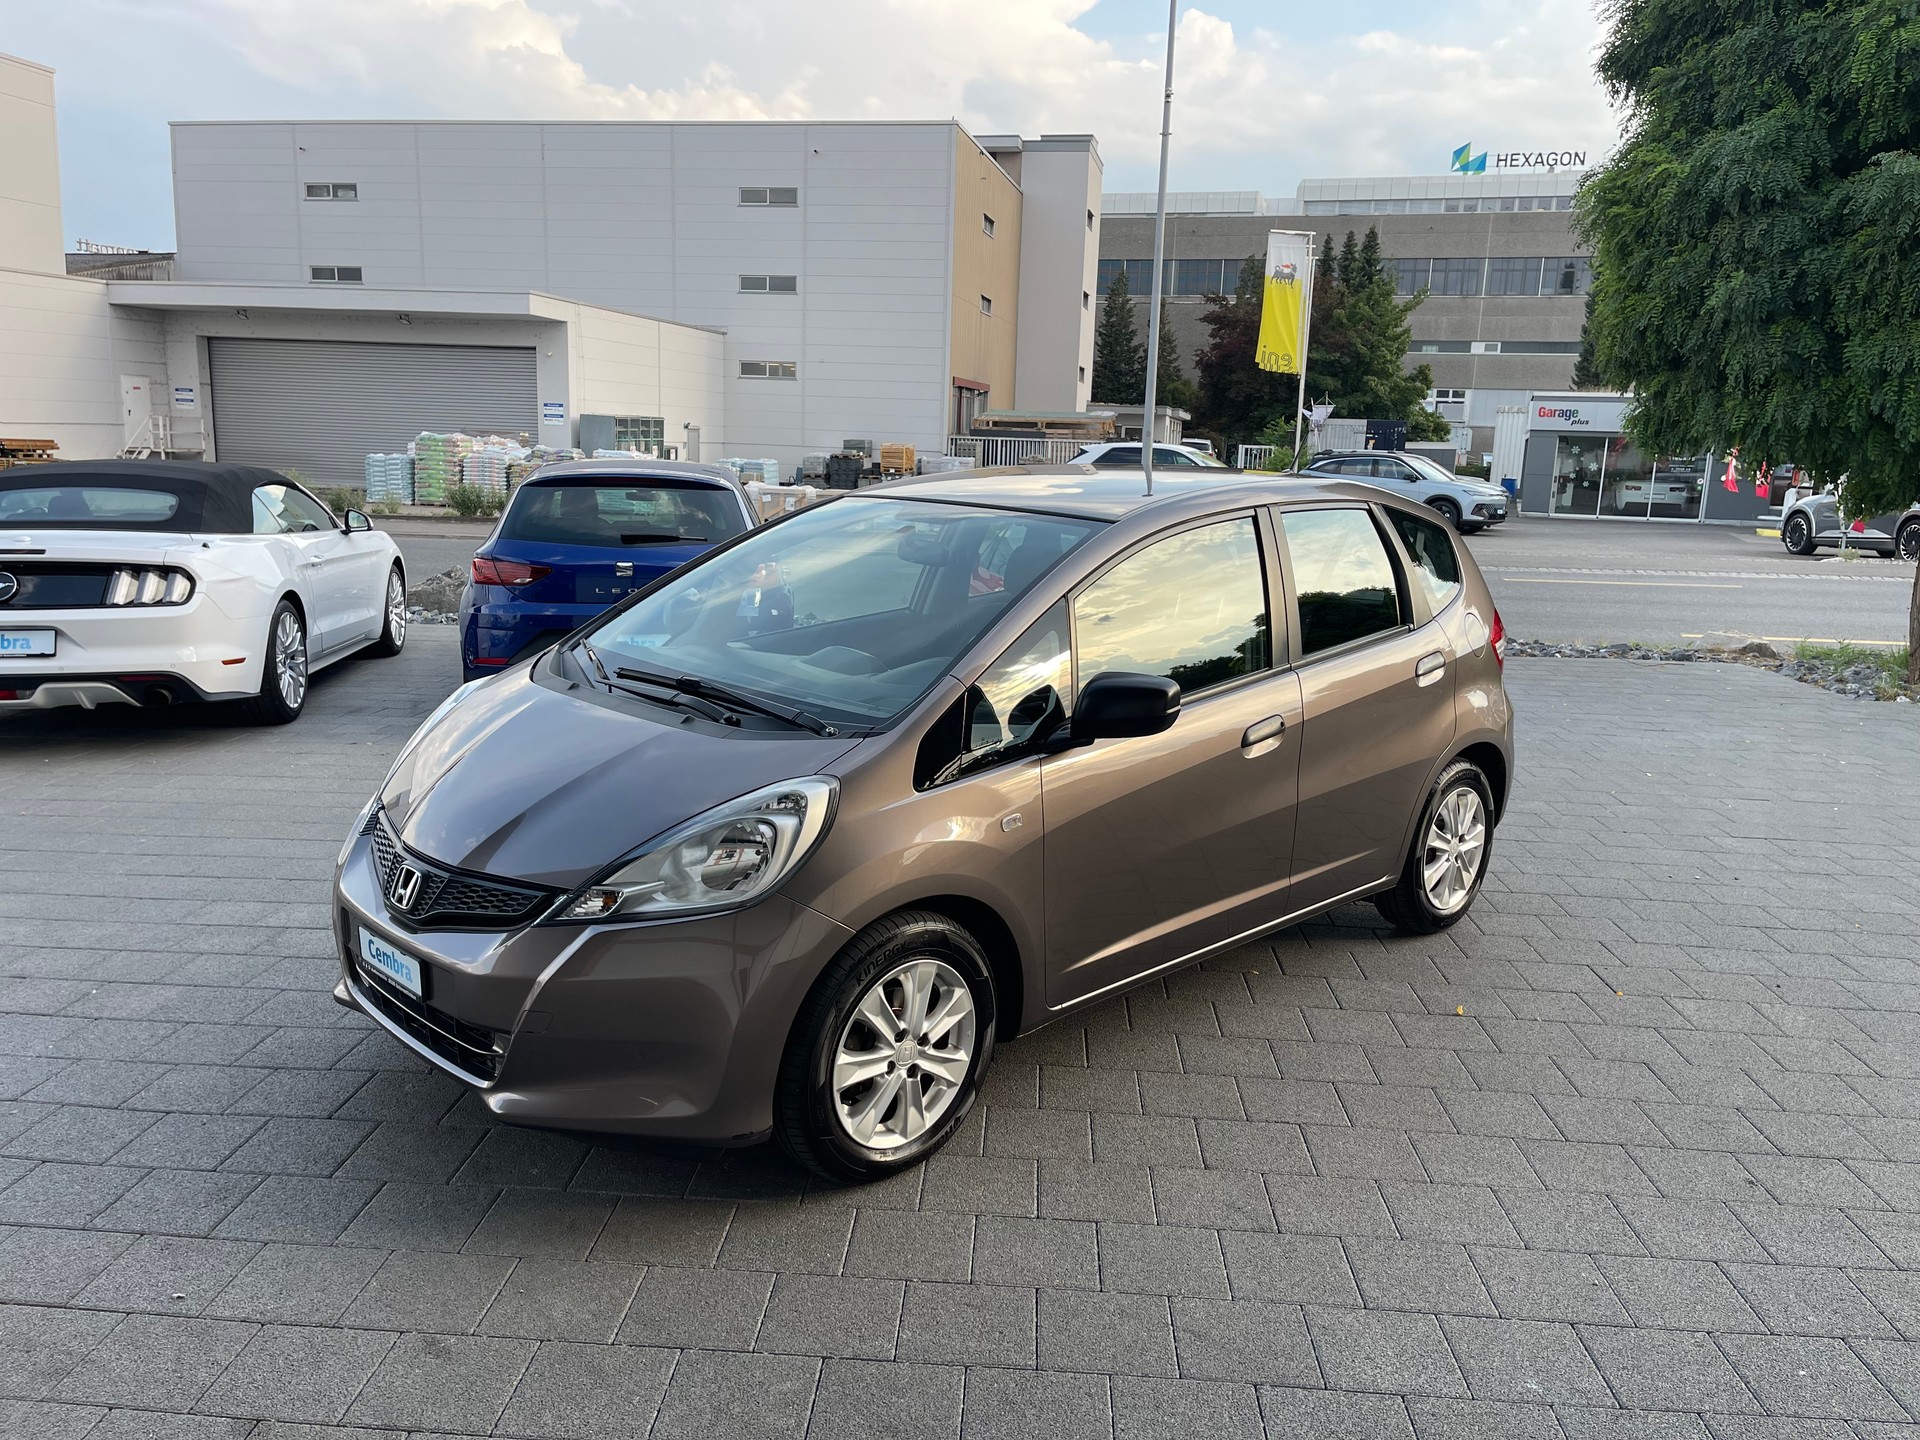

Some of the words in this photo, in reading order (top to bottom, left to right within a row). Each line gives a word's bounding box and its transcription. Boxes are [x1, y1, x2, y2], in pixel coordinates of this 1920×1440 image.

[1495, 151, 1586, 168] HEXAGON
[1538, 406, 1579, 421] Garage
[1570, 418, 1590, 426] plus
[367, 938, 413, 984] Cembra
